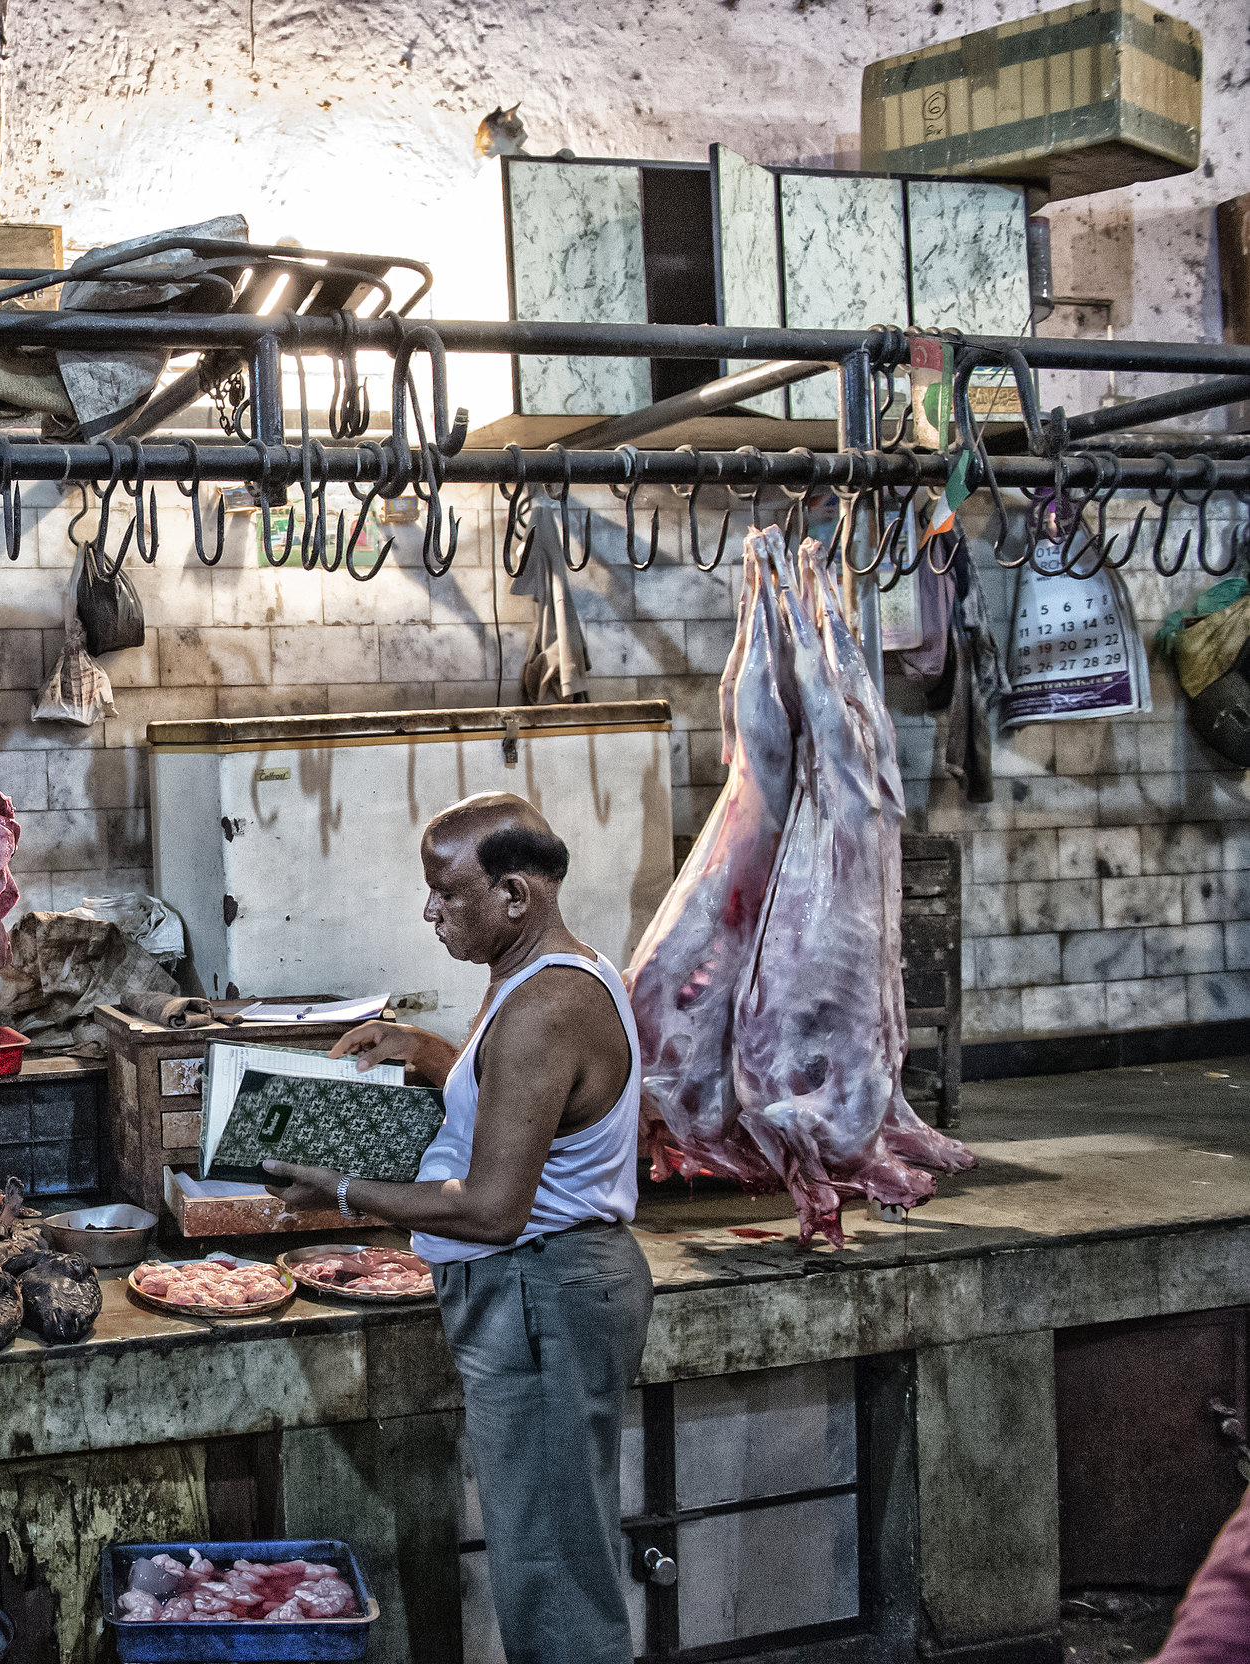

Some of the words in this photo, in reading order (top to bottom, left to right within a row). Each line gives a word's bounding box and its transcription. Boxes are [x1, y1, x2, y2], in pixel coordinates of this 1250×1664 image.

[1036, 546, 1060, 558] 014
[1040, 605, 1049, 615] 5
[1063, 602, 1072, 612] 6
[1085, 598, 1094, 609] 7
[1102, 594, 1108, 605] 8
[1019, 627, 1030, 638] 11
[1037, 624, 1052, 635] 12
[1060, 621, 1075, 632] 13
[1082, 618, 1097, 629] 14
[1103, 614, 1115, 625] 15
[1018, 646, 1031, 657] 18
[1037, 642, 1053, 654] 19
[1059, 640, 1077, 652] 20
[1084, 638, 1098, 649] 21
[1105, 633, 1119, 646] 22
[1038, 662, 1053, 673] 26
[1059, 659, 1077, 670] 27
[1083, 656, 1100, 668] 28
[1105, 653, 1121, 665] 29
